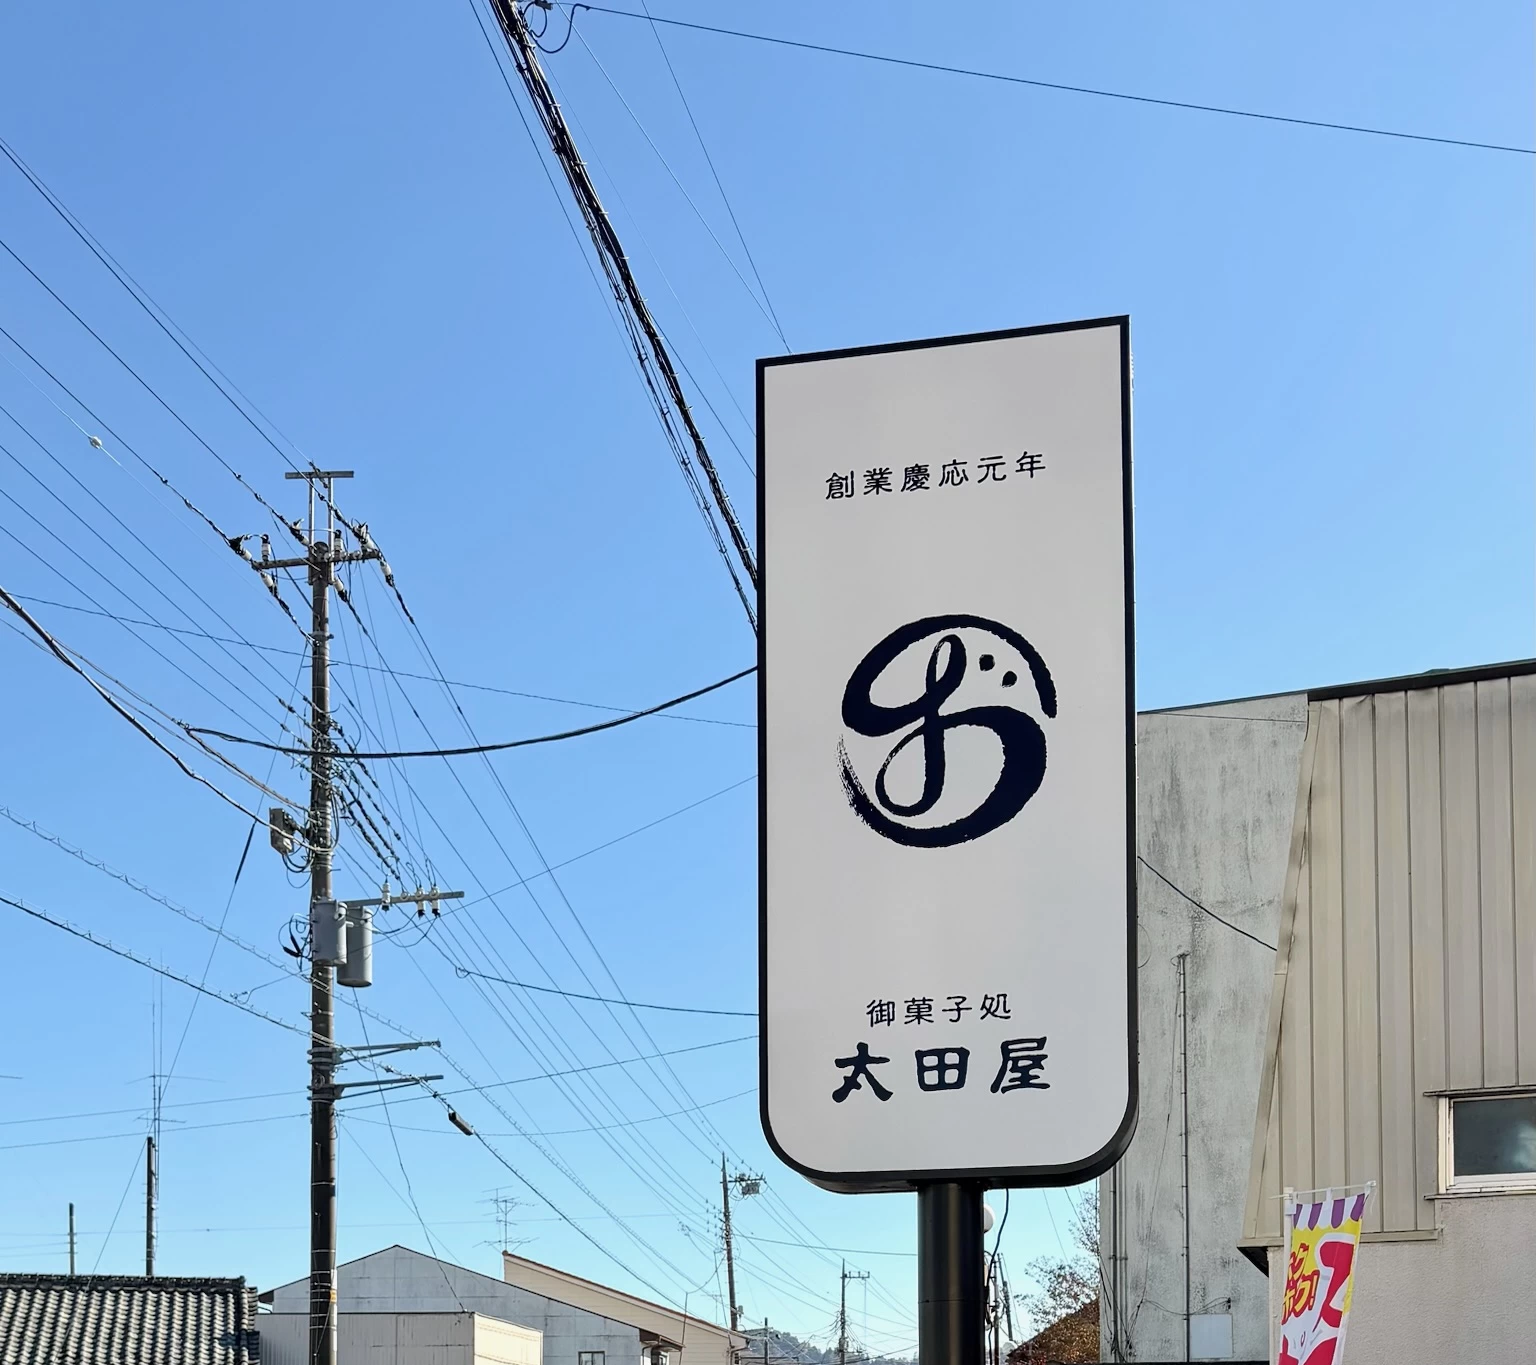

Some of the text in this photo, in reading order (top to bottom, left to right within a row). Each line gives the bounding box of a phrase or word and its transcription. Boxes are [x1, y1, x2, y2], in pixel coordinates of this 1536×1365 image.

[825, 450, 1046, 500] 創業慶応元年
[866, 993, 1012, 1028] 御菓子処
[831, 1036, 1051, 1104] 太田屋
